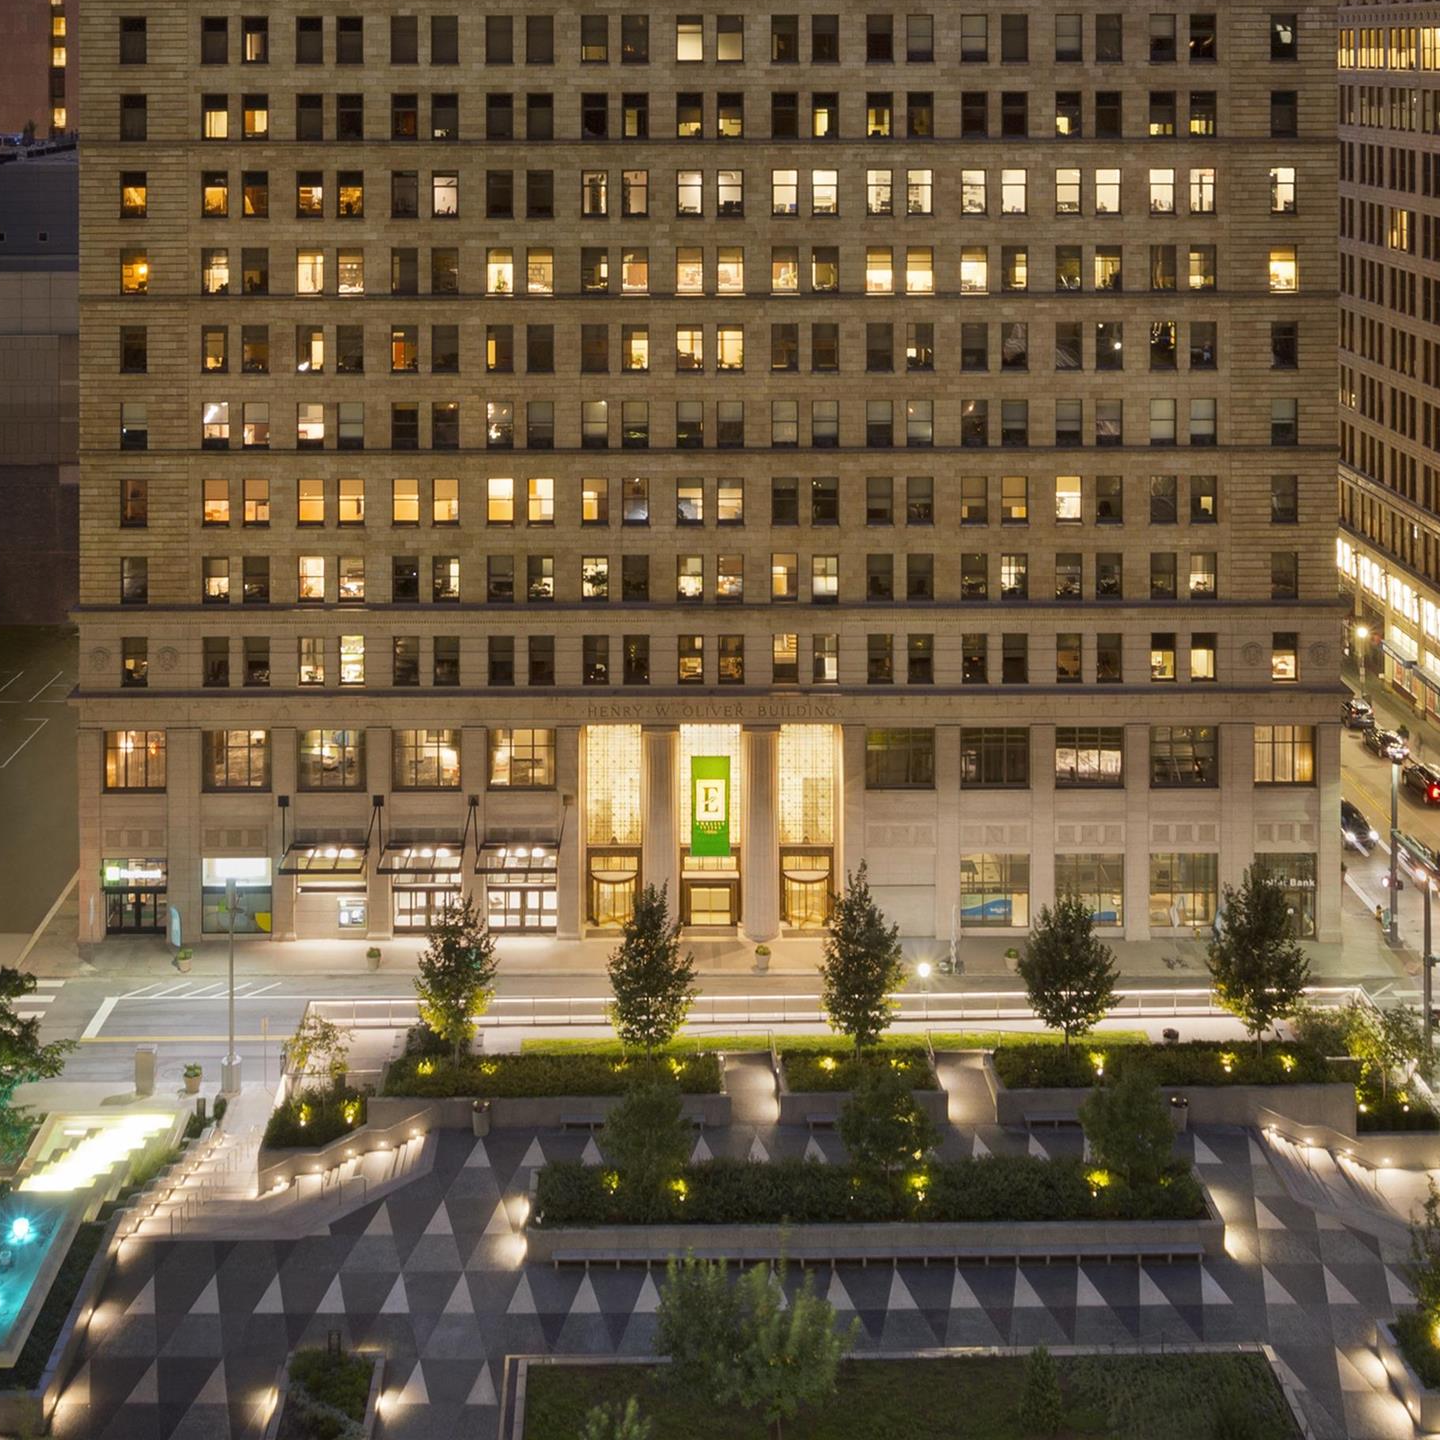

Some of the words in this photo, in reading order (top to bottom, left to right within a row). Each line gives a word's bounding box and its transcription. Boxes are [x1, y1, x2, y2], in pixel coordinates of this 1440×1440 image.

[587, 704, 642, 718] HENRY
[655, 704, 671, 718] W
[682, 704, 745, 718] OLIVER
[758, 704, 837, 718] BUILDING
[1290, 878, 1316, 887] Bank
